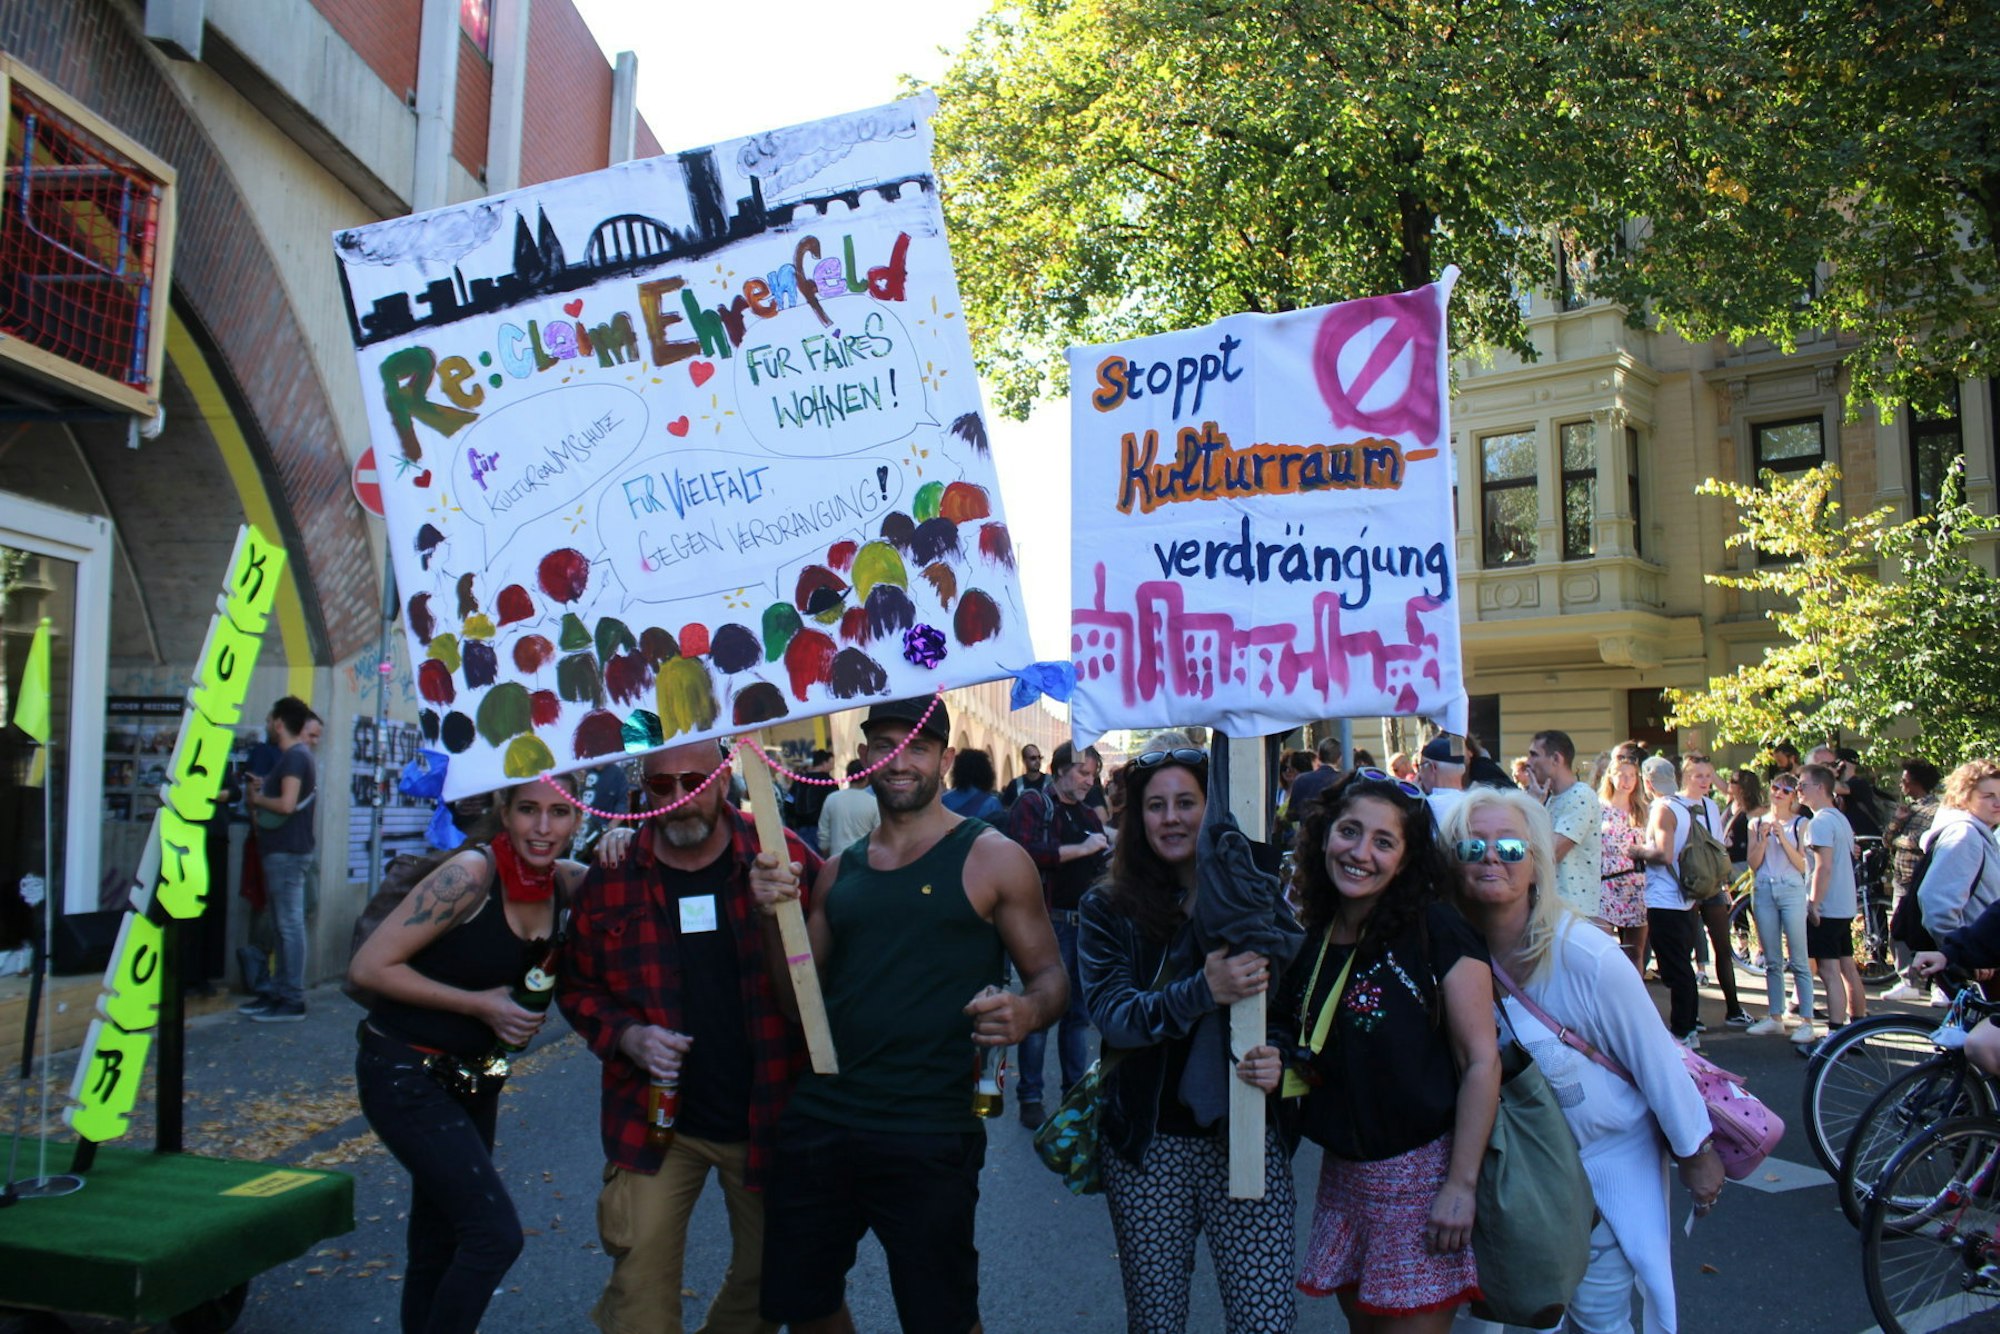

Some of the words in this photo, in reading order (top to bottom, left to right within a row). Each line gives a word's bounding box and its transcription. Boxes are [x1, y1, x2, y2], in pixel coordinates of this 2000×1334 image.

[746, 345, 802, 386] FÜR
[1092, 334, 1244, 420] Stoppt
[467, 447, 500, 491] für
[638, 519, 724, 572] GEGEN
[1154, 515, 1451, 611] verdrängung
